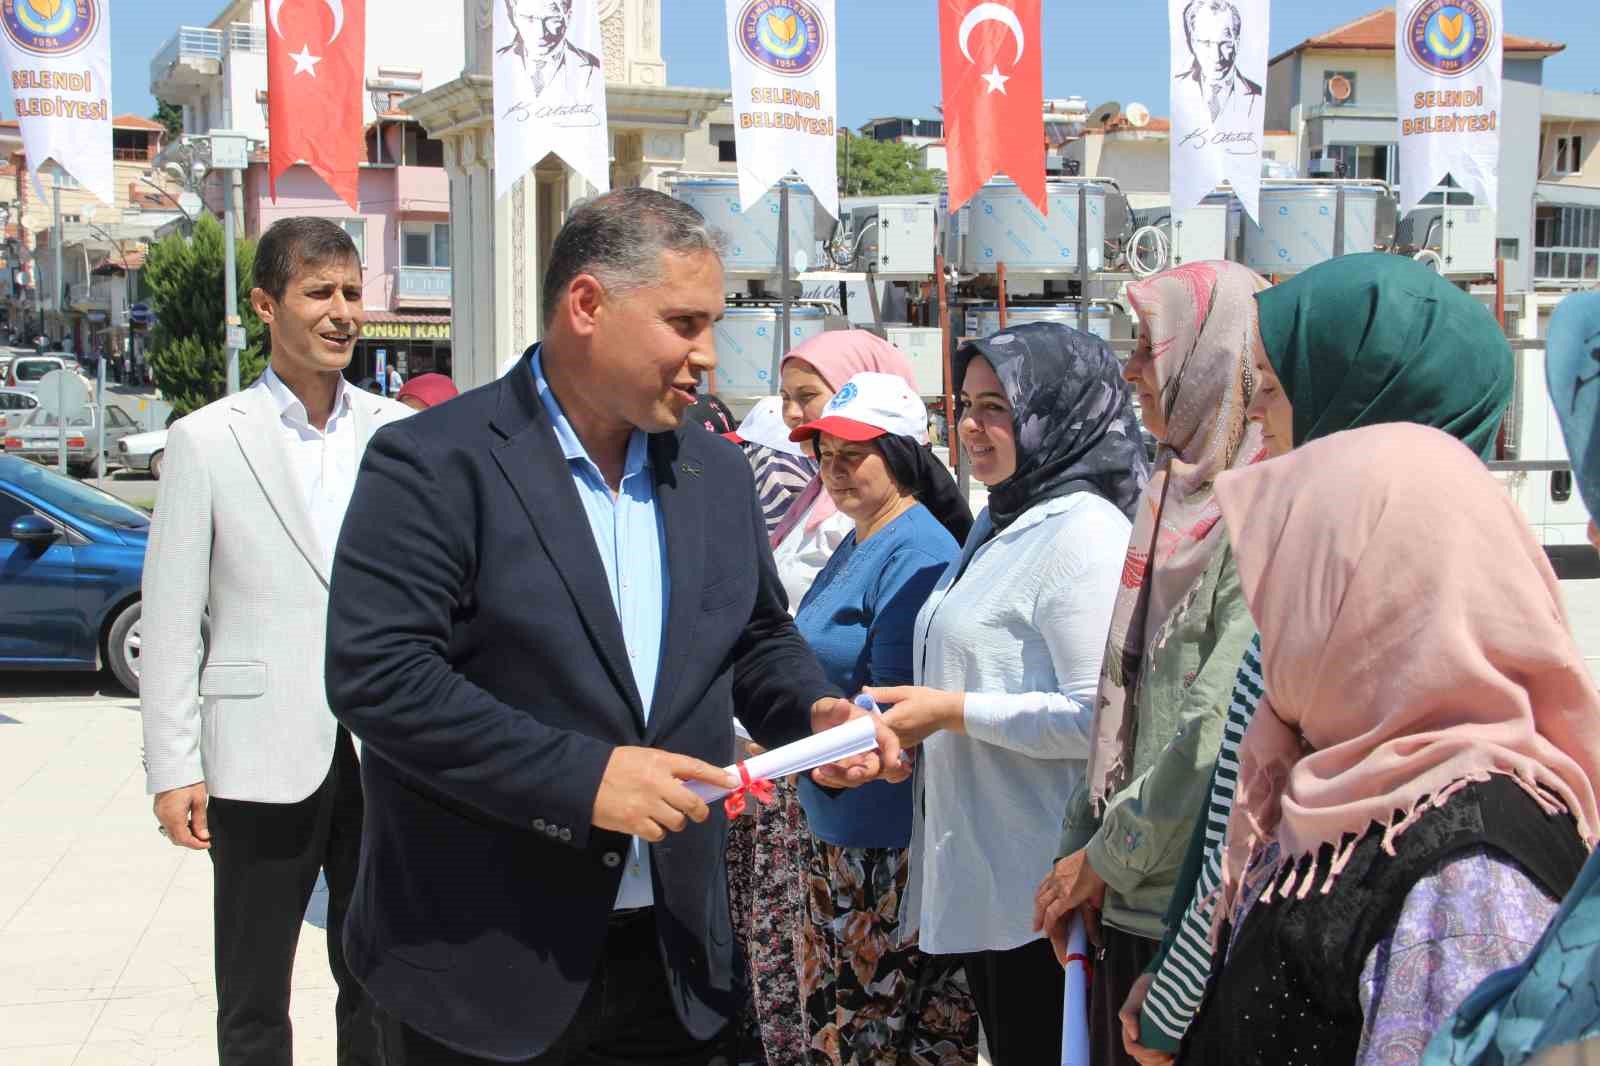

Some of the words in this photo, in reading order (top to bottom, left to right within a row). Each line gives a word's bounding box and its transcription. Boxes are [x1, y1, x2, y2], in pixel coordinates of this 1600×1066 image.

[751, 87, 820, 110] SELENDİ
[1414, 86, 1483, 109] SELENDİ
[740, 111, 834, 136] BELEDİYESİ
[1402, 111, 1496, 136] BELEDİYESİ
